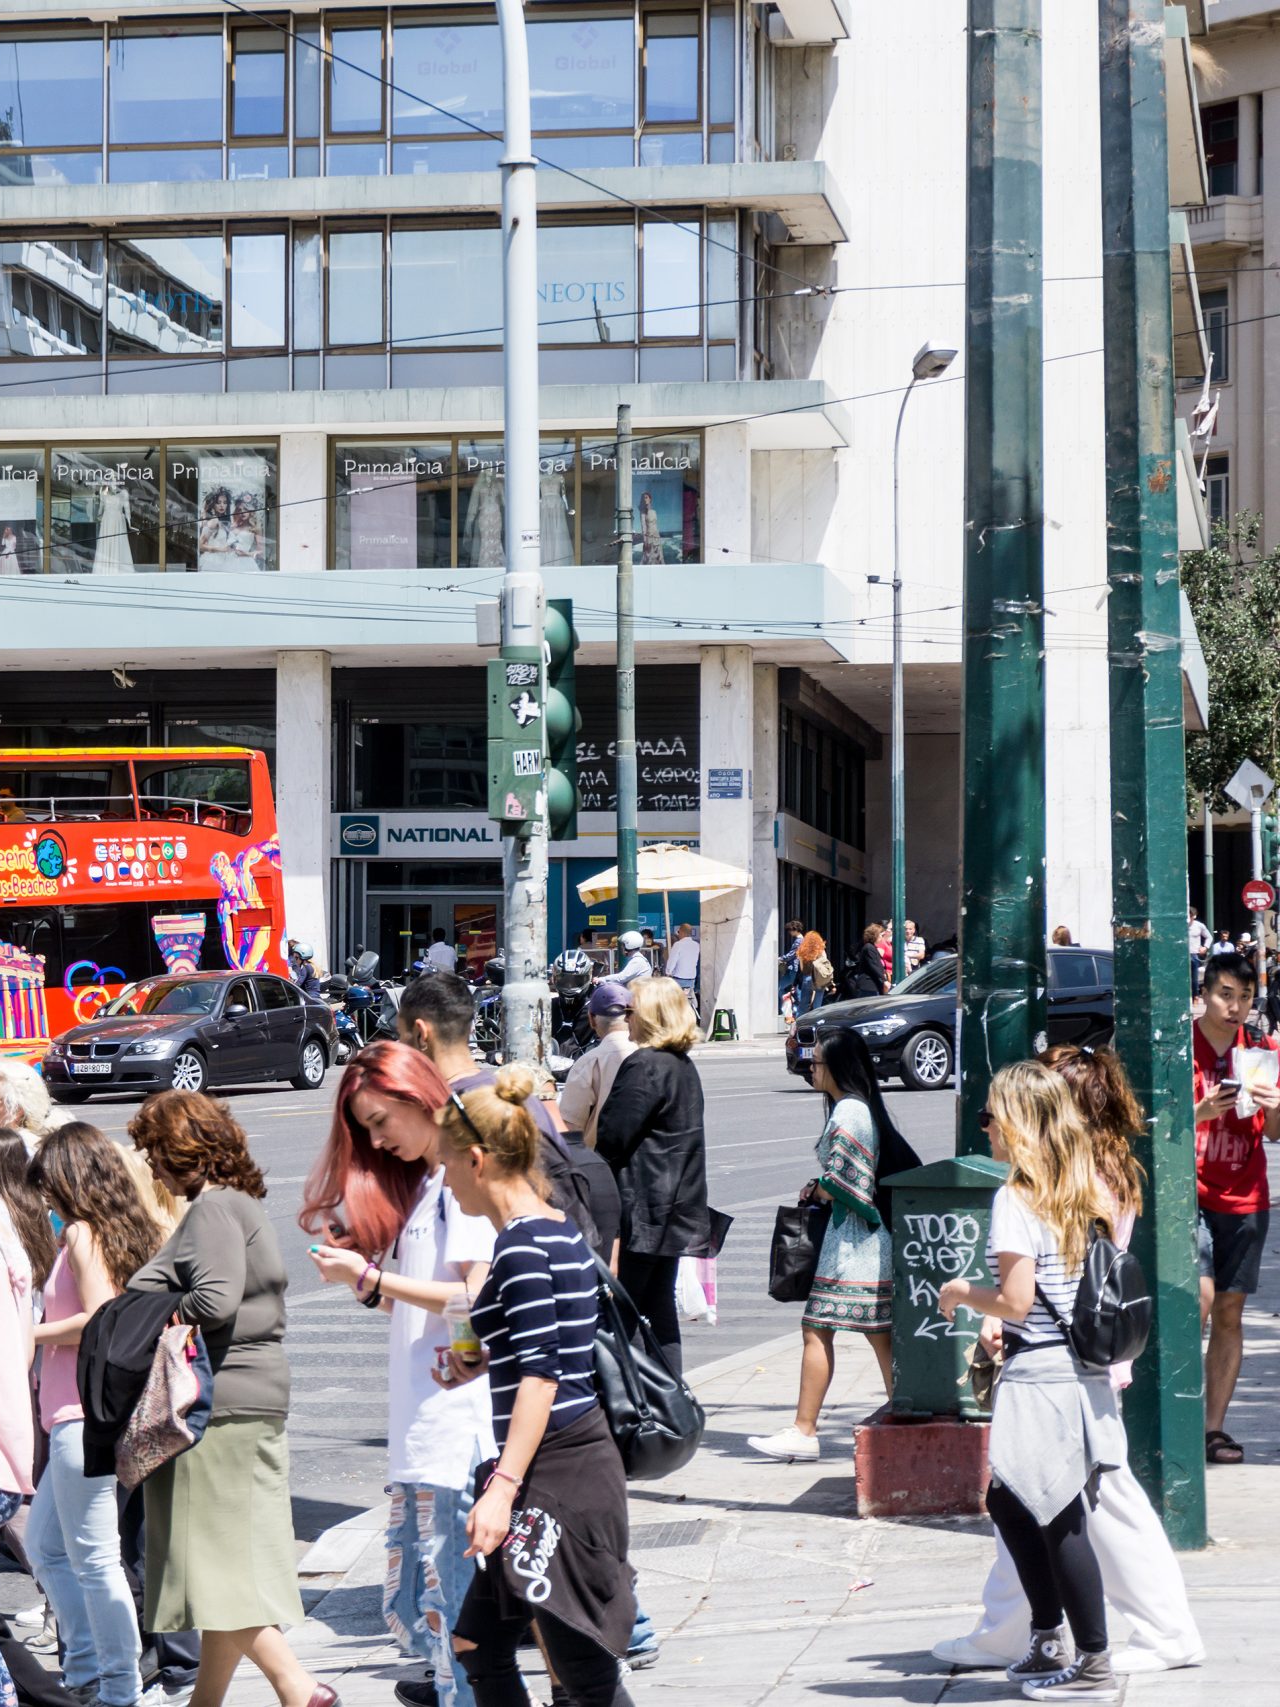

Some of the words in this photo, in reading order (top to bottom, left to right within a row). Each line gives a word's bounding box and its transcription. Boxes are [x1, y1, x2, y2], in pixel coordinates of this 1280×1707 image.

[555, 55, 616, 71] Global
[56, 462, 154, 481] Primalicia
[344, 457, 443, 476] Primalicia
[359, 533, 408, 545] Primalicia
[387, 827, 493, 842] NATIONAL
[10, 873, 58, 898] Beaches
[513, 1512, 562, 1603] Sweet
